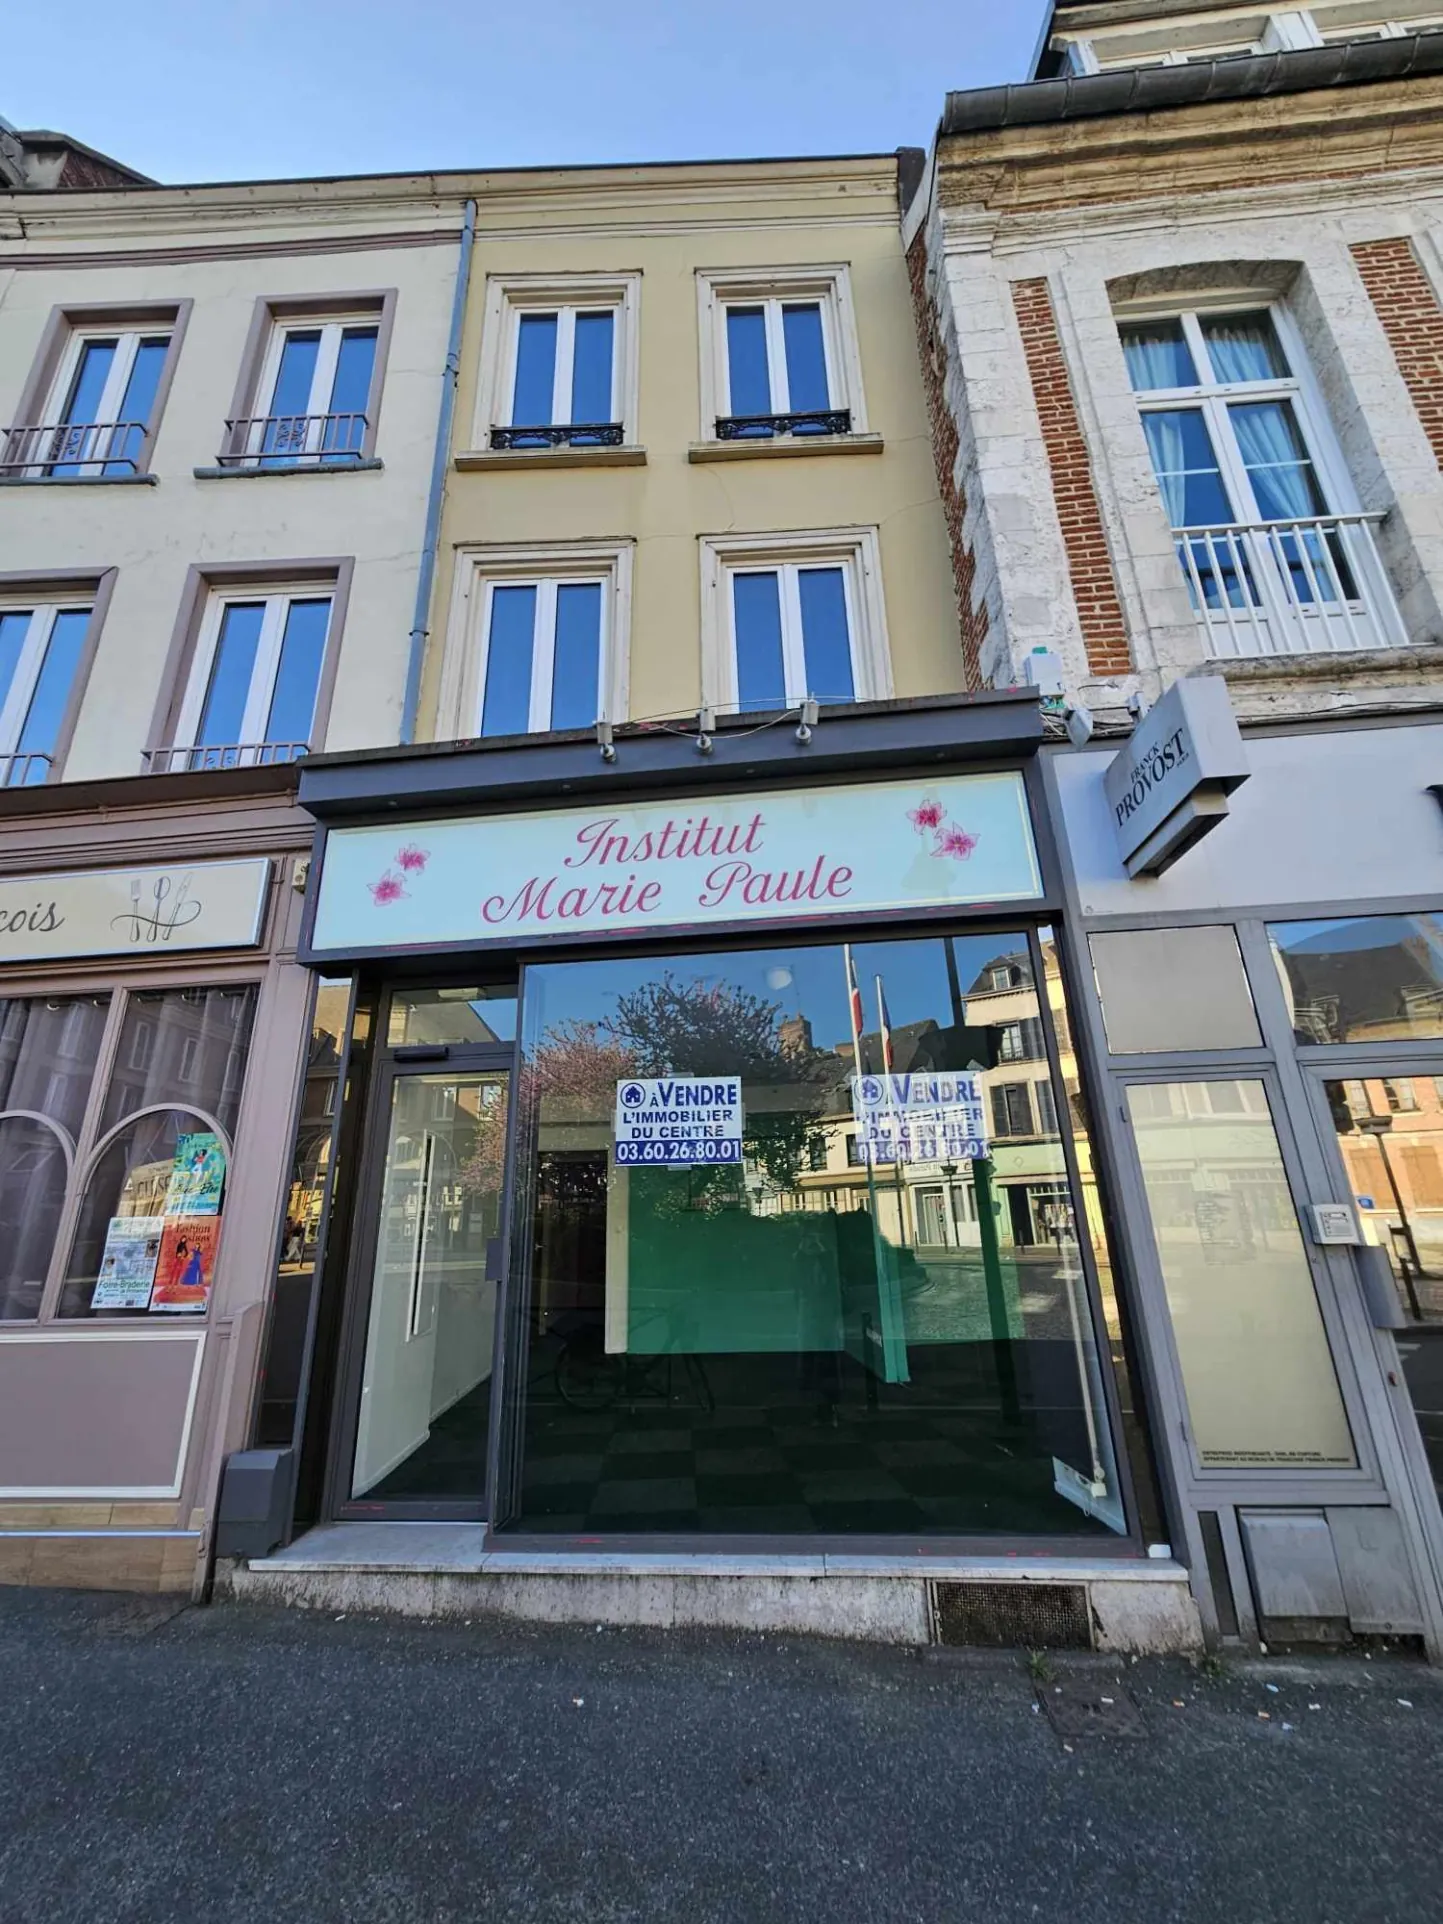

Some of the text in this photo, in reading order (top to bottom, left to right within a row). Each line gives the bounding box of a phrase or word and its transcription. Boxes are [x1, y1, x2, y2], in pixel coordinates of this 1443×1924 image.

[1130, 742, 1159, 783] FRANCK
[1115, 728, 1185, 827] PROVOST
[564, 813, 766, 868] Institut
[482, 854, 853, 923] Marie Paule
[649, 1082, 737, 1107] À VENDRE
[623, 1109, 734, 1124] L'IMMOBILIER
[631, 1125, 725, 1139] DU CENTRE
[870, 1127, 892, 1139] DU
[617, 1140, 740, 1160] 03.60.26.80.01
